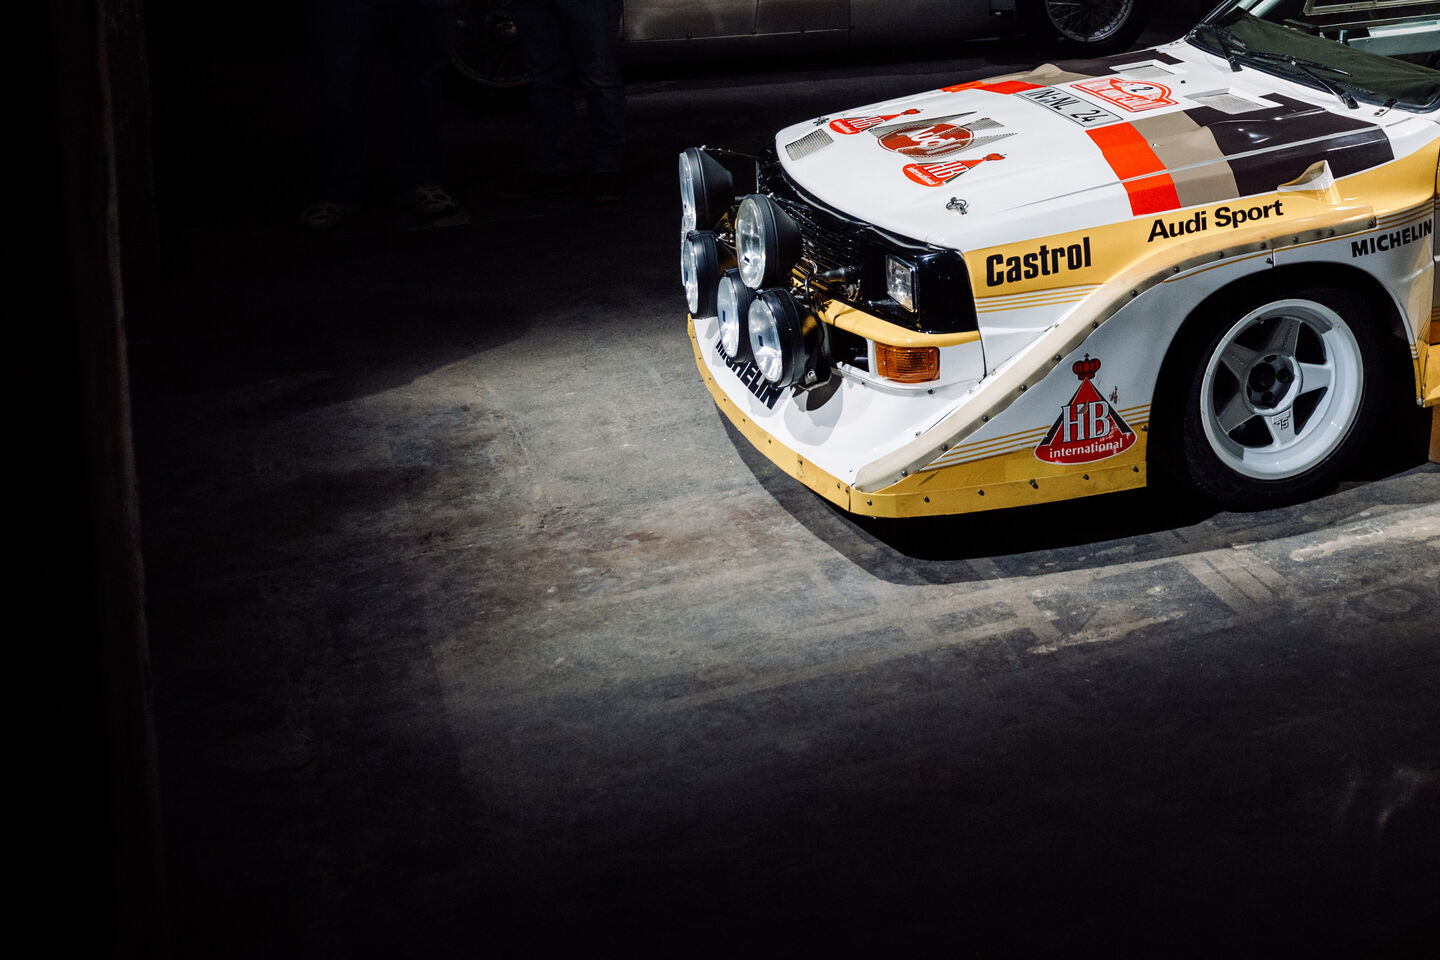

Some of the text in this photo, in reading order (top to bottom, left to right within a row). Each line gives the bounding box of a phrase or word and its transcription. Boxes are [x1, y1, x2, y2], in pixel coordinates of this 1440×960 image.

[1070, 109, 1109, 123] 24
[1147, 199, 1284, 243] Audi Sport
[1351, 218, 1432, 258] MICHELIN
[986, 237, 1092, 287] Castrol
[1061, 400, 1112, 444] HB
[1049, 438, 1123, 459] international
